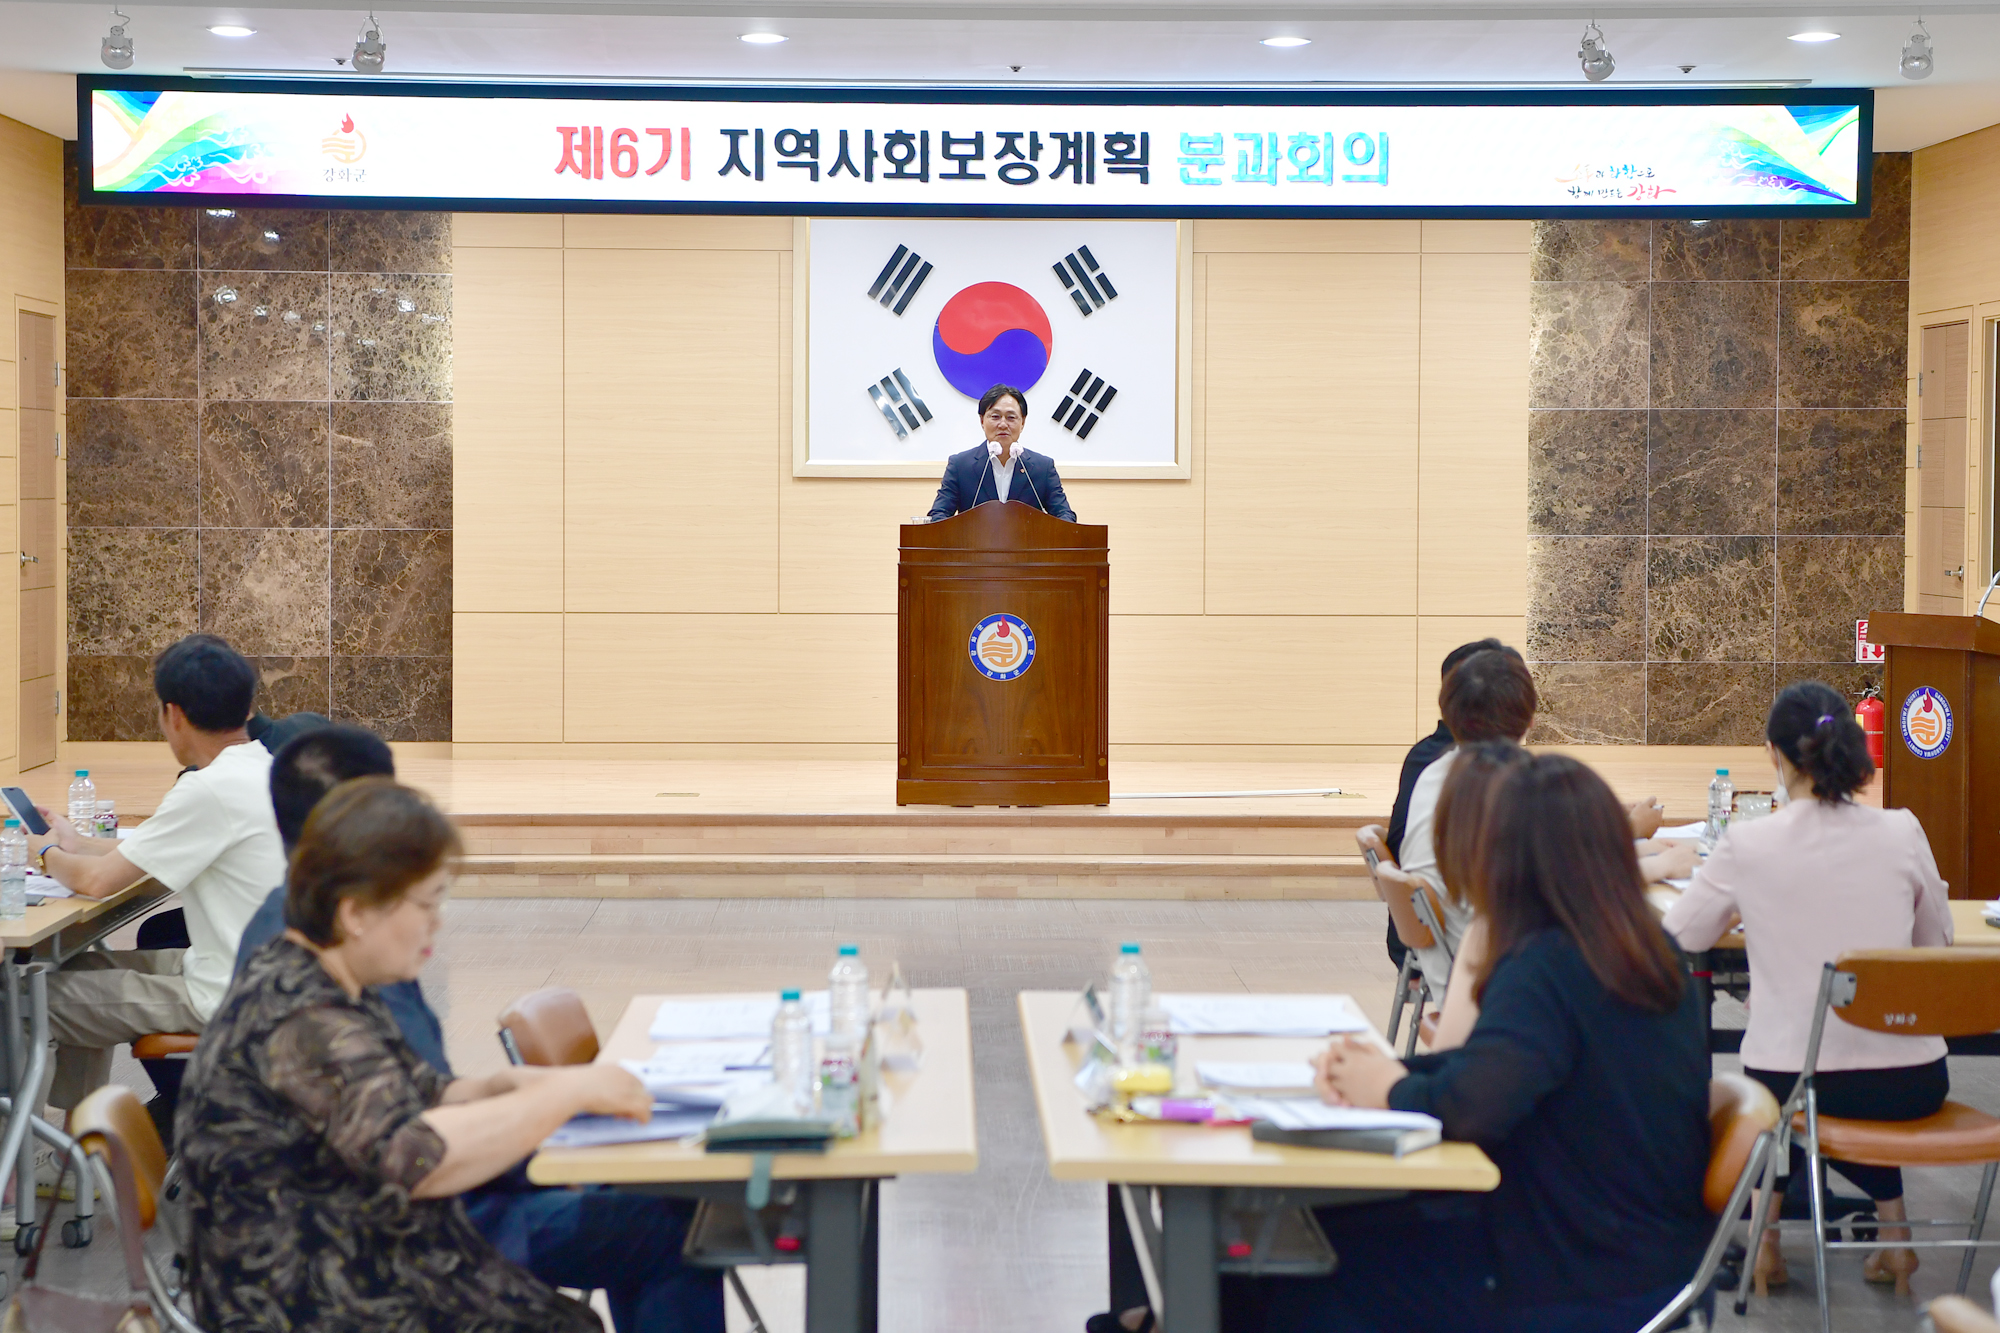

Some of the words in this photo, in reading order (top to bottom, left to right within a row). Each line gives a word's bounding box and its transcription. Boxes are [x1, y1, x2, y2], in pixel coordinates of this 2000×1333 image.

[555, 125, 691, 182] 제6기
[718, 128, 1150, 185] 지역사회보장계획
[1177, 131, 1389, 186] 분과회의
[322, 167, 367, 183] 강화군
[1627, 183, 1677, 201] 강화
